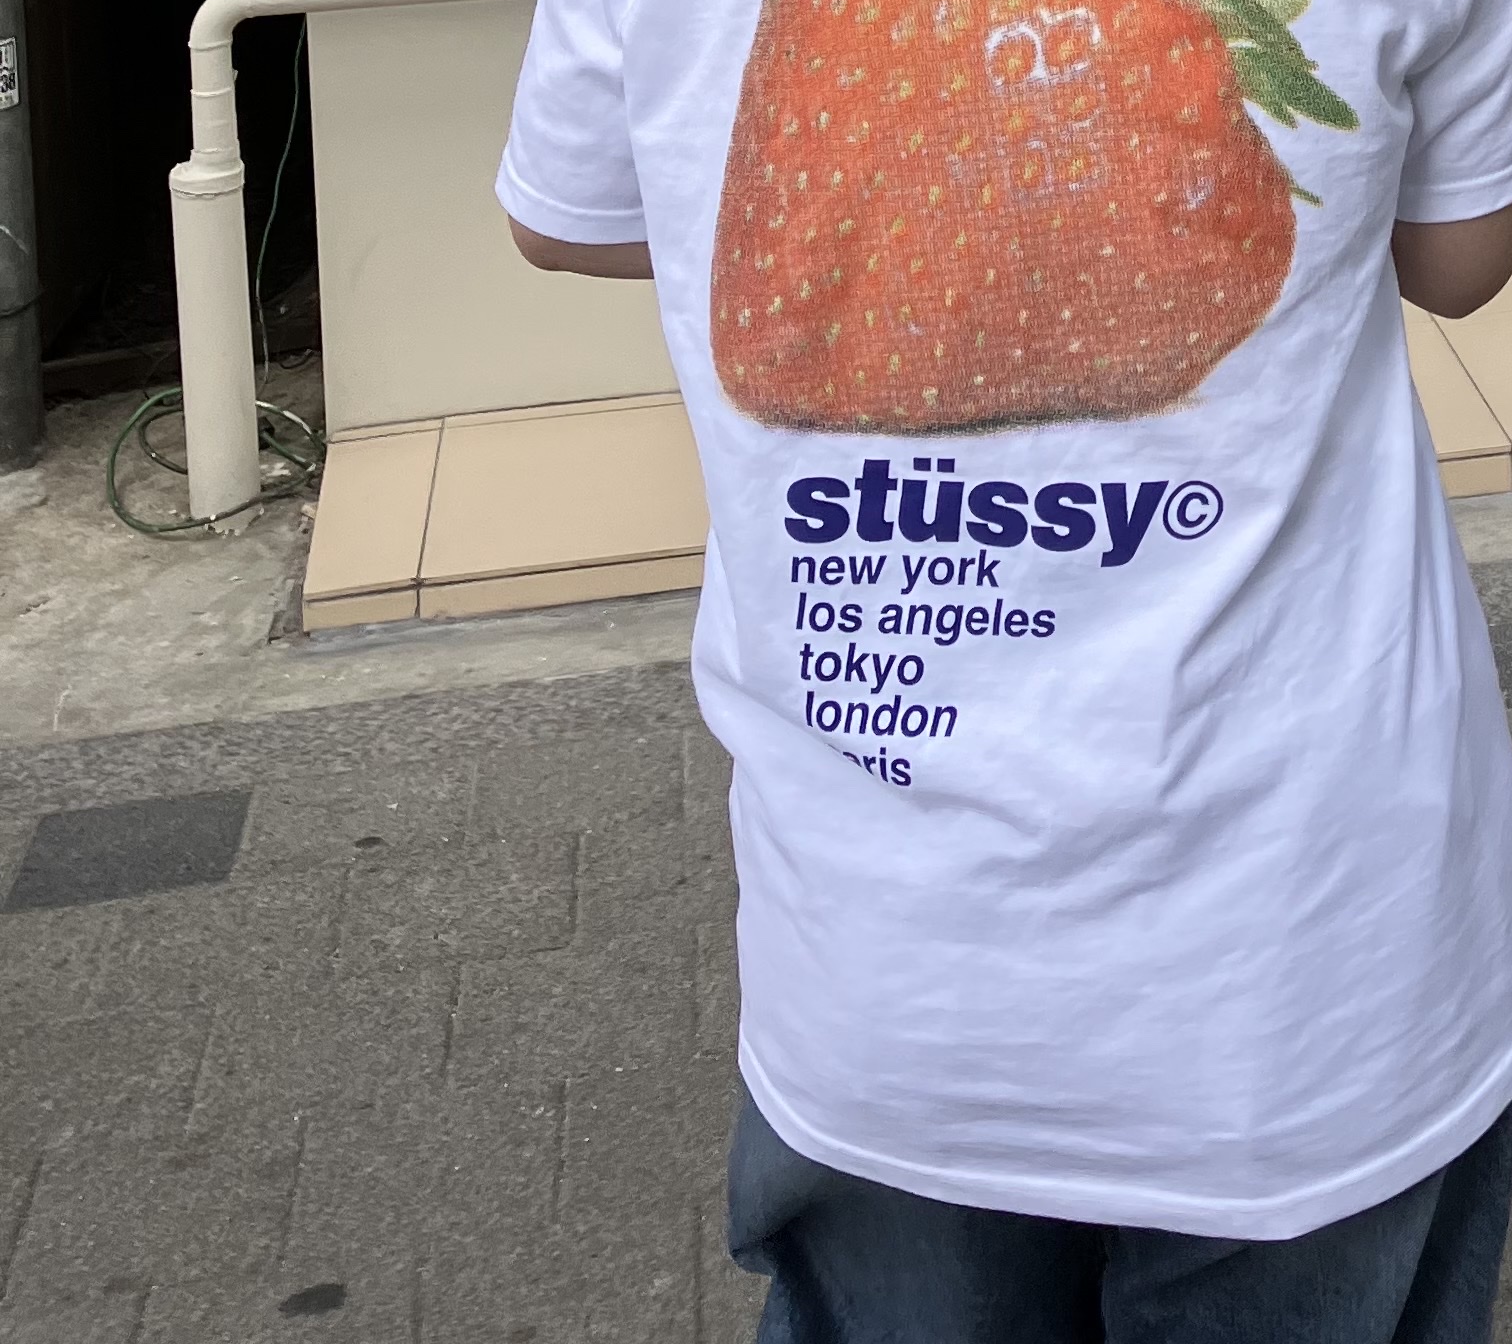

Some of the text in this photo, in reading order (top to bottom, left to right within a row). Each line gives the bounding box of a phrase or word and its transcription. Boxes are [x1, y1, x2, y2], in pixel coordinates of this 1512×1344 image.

[791, 549, 1001, 596] new york
[795, 592, 1056, 646] los angeles
[799, 642, 924, 696] tokyo
[805, 690, 959, 739] london
[842, 746, 912, 787] ris
